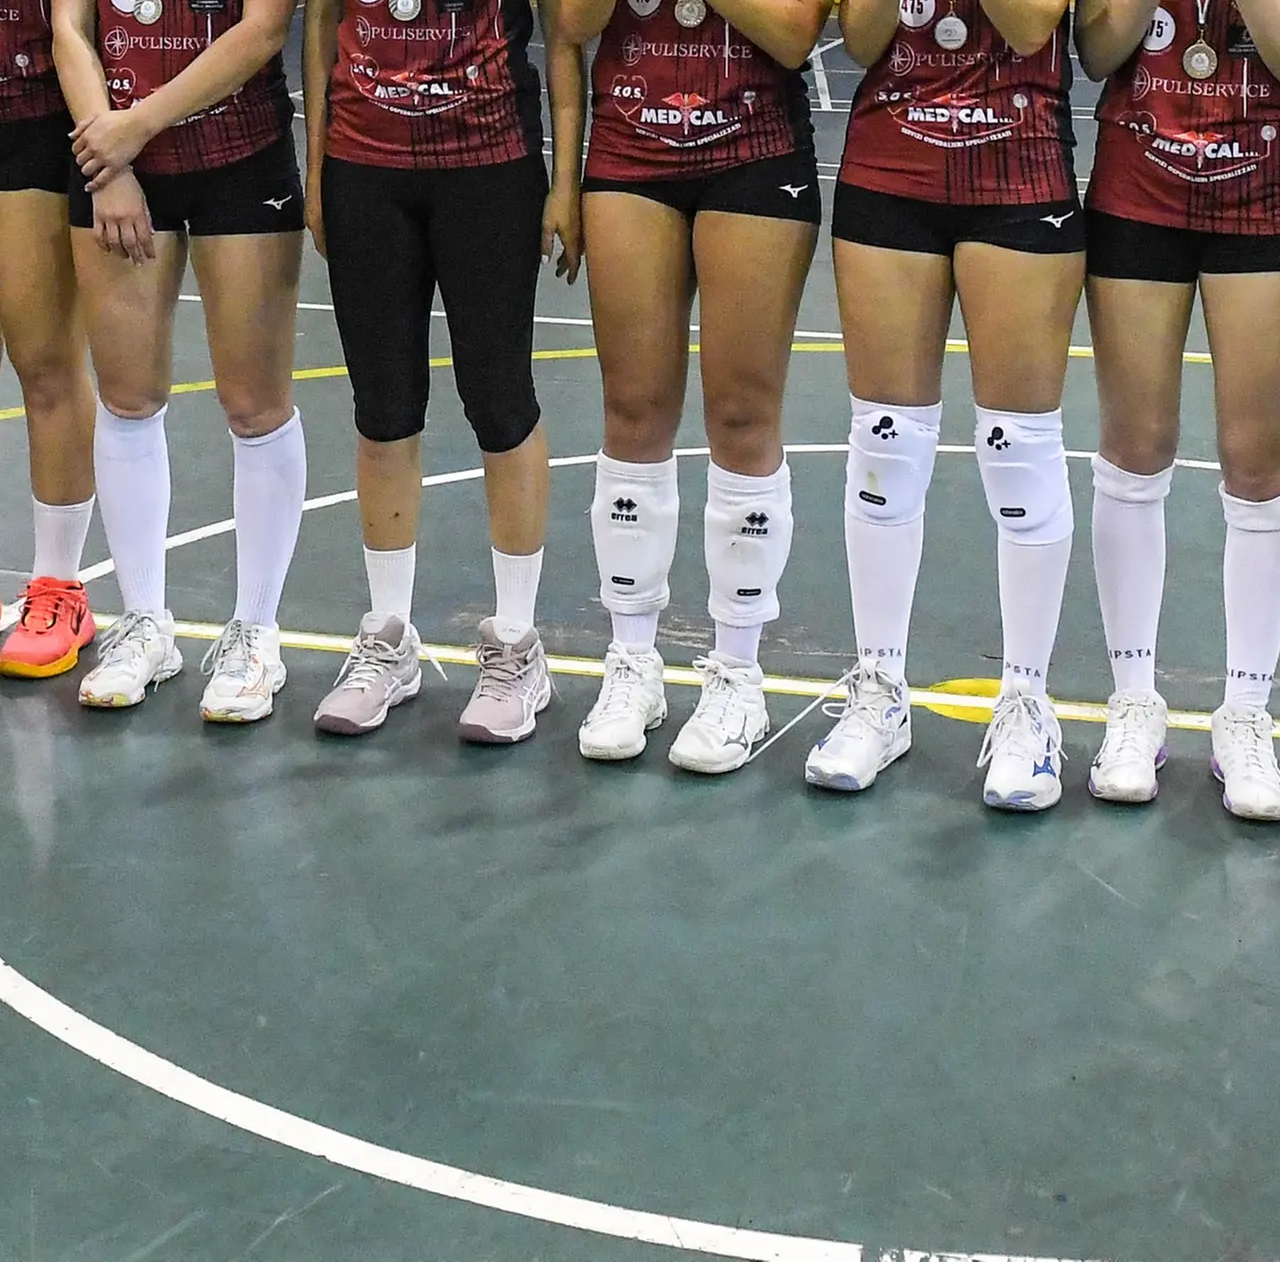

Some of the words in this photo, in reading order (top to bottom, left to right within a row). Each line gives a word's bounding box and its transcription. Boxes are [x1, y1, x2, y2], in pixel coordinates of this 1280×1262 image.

[642, 41, 753, 60] PULISERVICE
[1151, 76, 1270, 98] PULISERVICE
[860, 647, 903, 659] IPSTA
[1109, 649, 1152, 660] IPSTA
